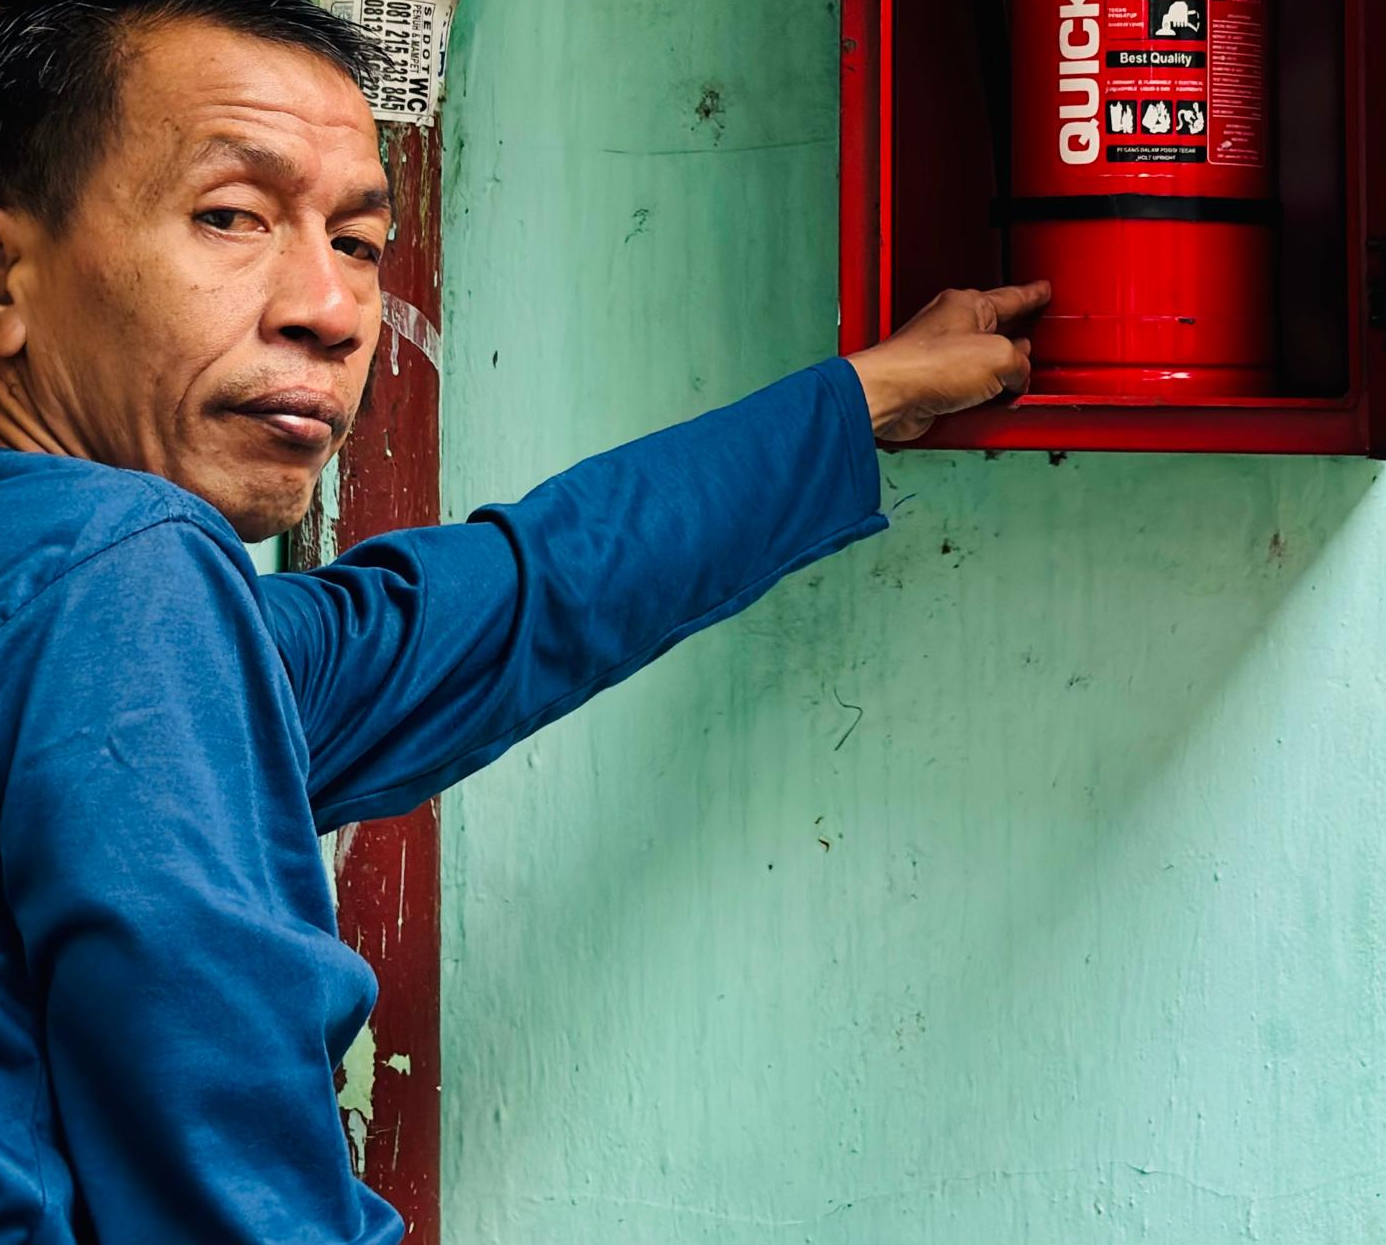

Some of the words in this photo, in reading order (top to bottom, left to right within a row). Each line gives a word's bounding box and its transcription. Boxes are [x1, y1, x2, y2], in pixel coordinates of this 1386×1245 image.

[386, 2, 411, 25] 081
[412, 4, 421, 30] PENUH
[385, 30, 410, 54] 215
[422, 7, 432, 75] SEDOT
[410, 40, 420, 73] MAMPET
[1120, 52, 1147, 63] Best
[1150, 52, 1192, 67] Quality
[381, 87, 406, 110] 845
[407, 78, 429, 112] WC
